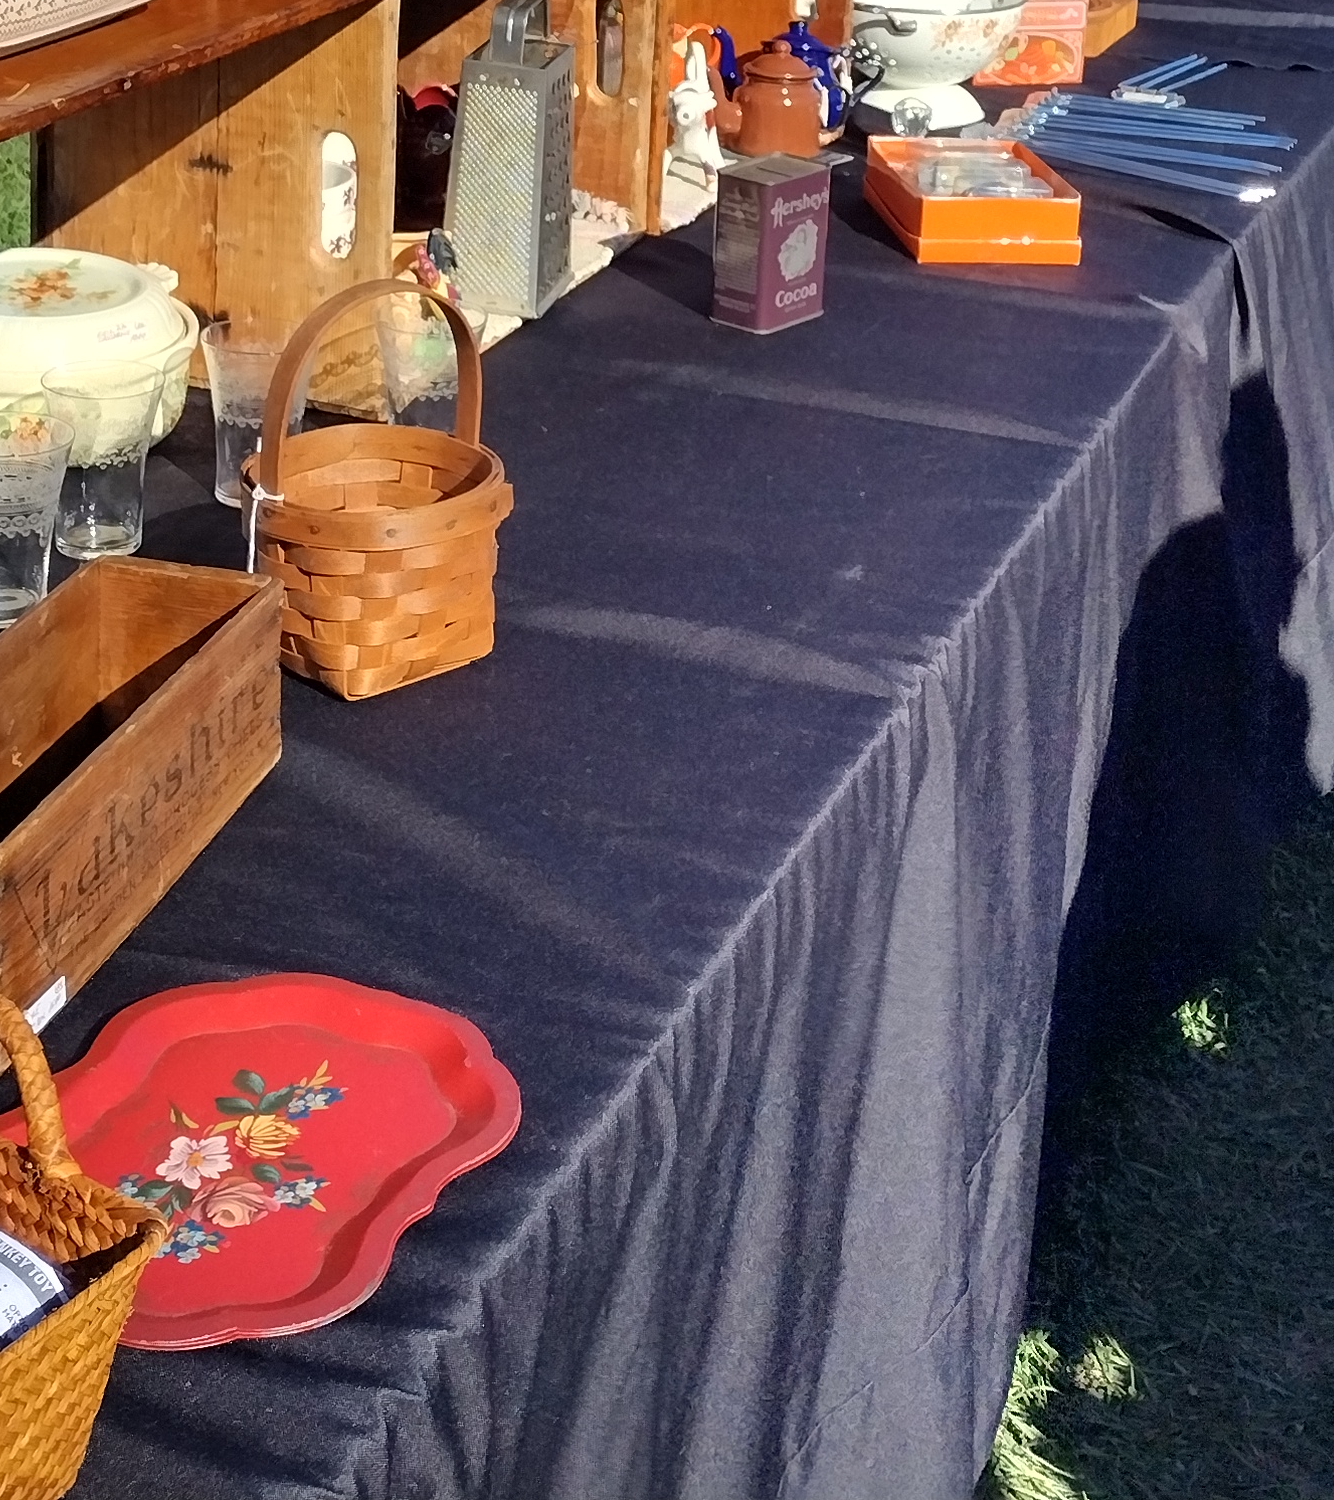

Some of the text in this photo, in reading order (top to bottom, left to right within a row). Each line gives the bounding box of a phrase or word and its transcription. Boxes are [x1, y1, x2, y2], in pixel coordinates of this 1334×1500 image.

[775, 282, 817, 308] Cocoa
[33, 678, 269, 940] Lakeshire
[27, 1266, 54, 1293] TOY
